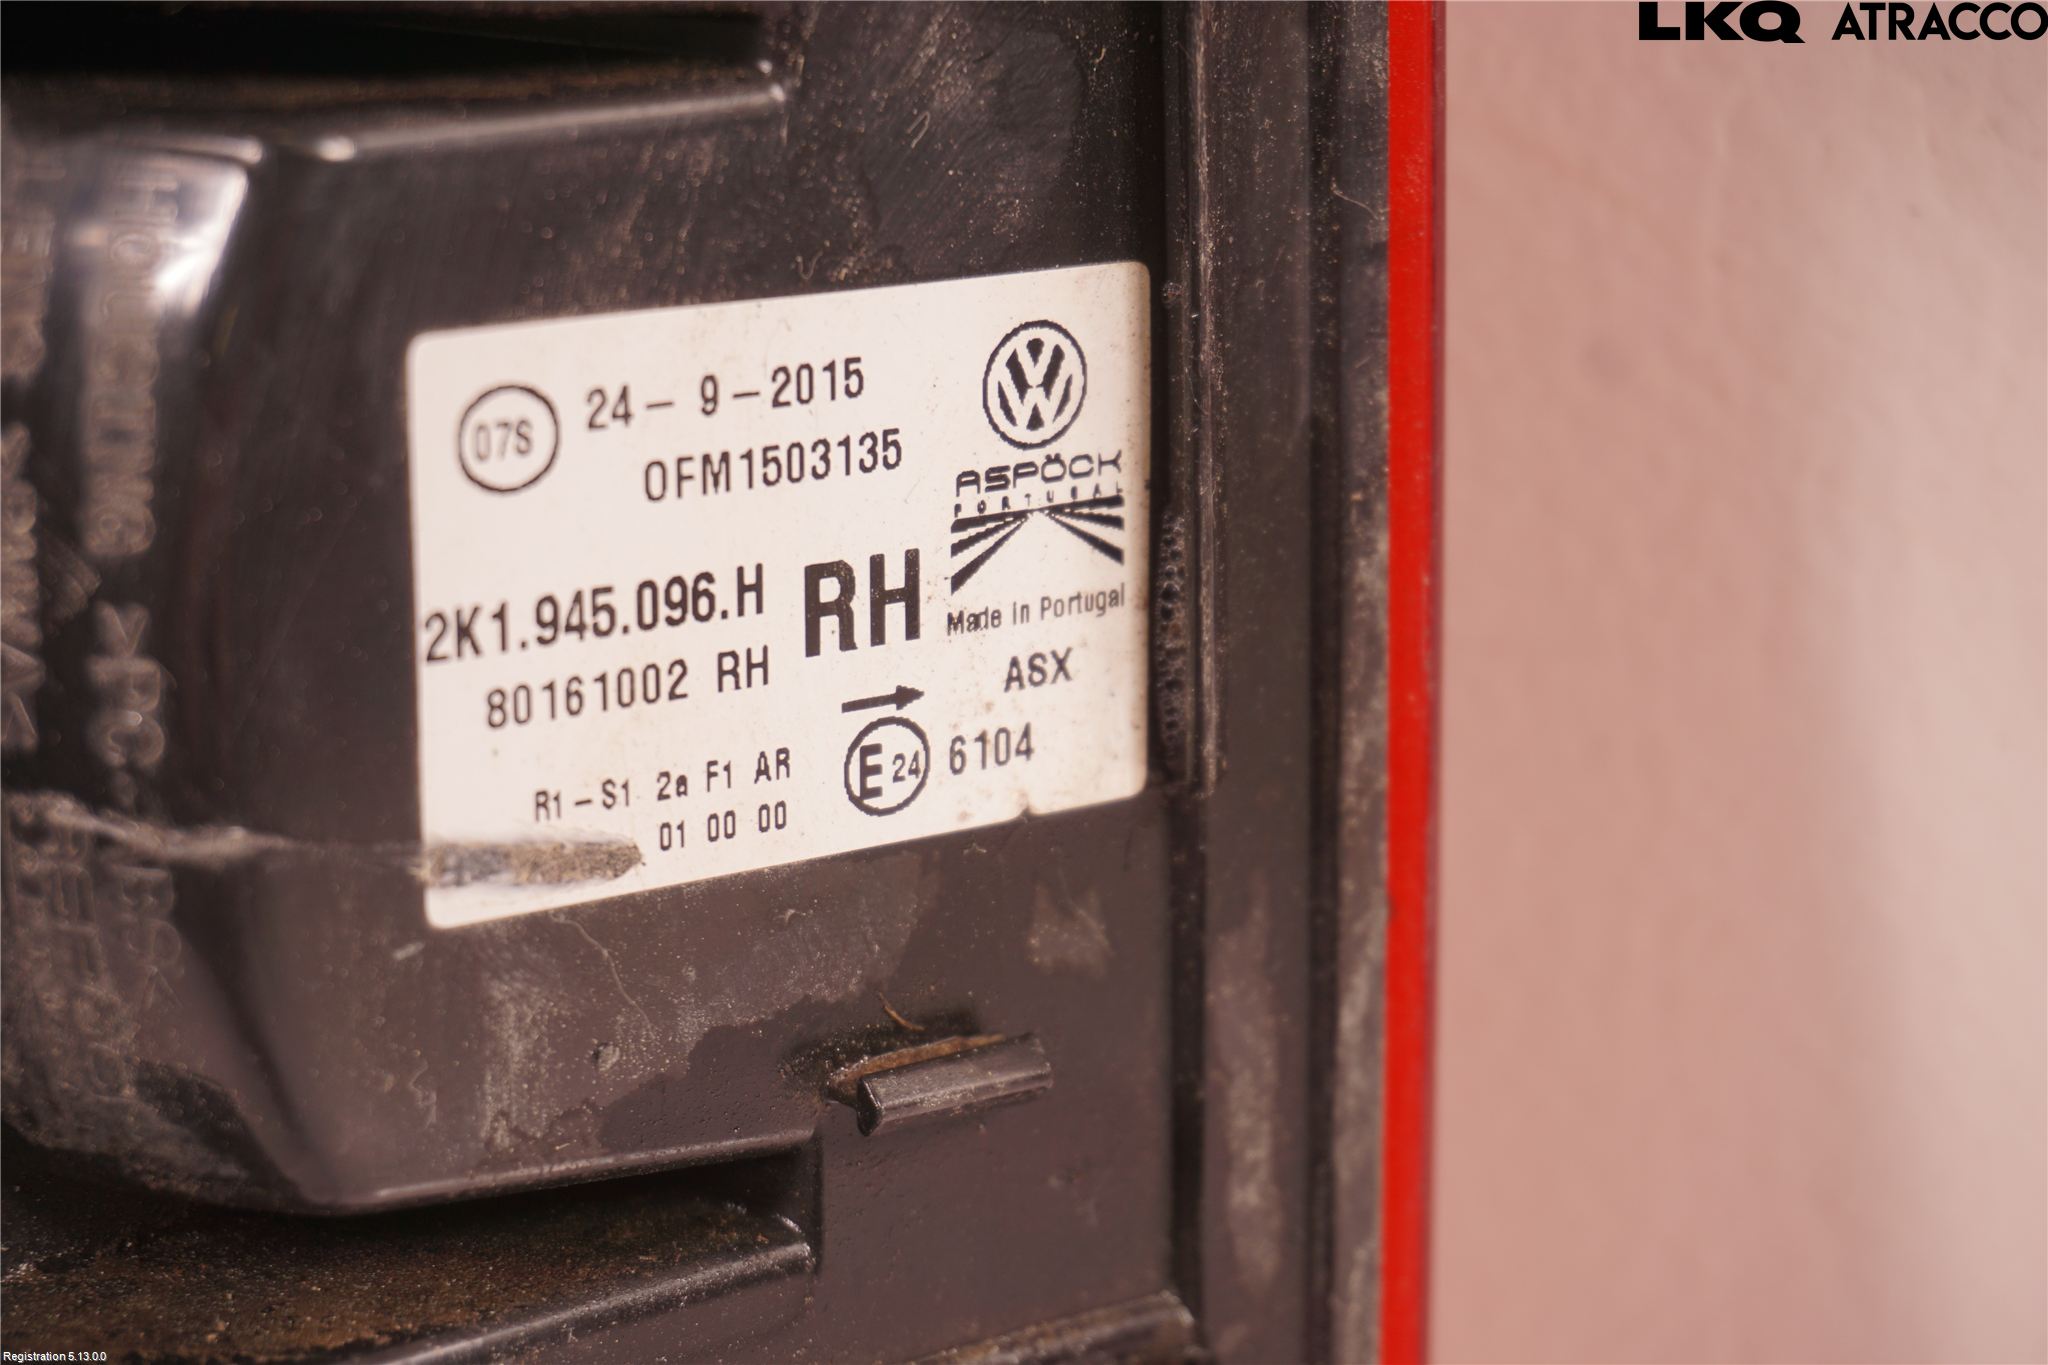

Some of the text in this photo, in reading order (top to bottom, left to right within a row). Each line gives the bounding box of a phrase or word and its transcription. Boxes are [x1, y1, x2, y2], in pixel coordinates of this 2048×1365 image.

[475, 418, 534, 461] 07S
[956, 450, 1122, 497] ASPÖCK
[425, 563, 764, 663] 2K1.945.096.H
[805, 548, 921, 657] RH
[947, 583, 1125, 636] Made in Portugal
[486, 645, 769, 729] 80161002 RH
[1004, 648, 1072, 693] ASX
[706, 759, 732, 793] F1
[754, 747, 791, 784] AR
[949, 723, 1034, 776] 6104
[659, 800, 787, 852] 01 00 00
